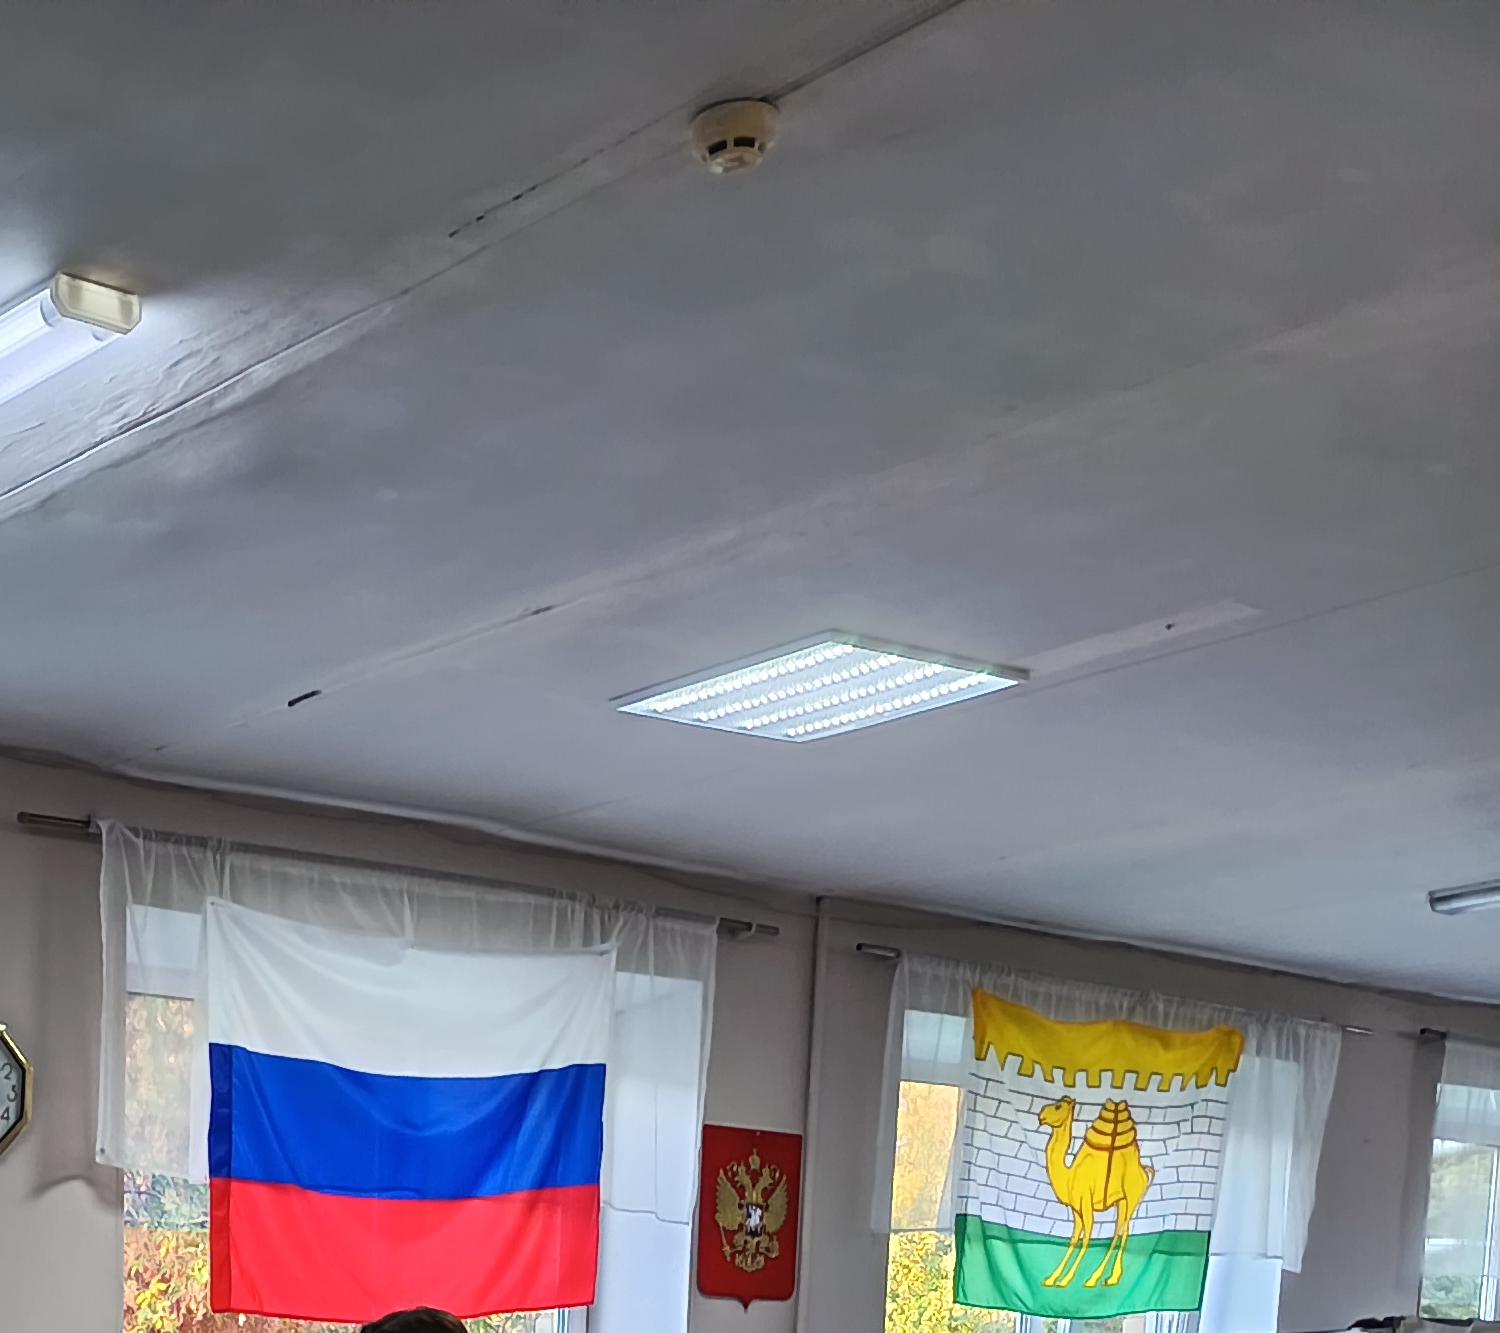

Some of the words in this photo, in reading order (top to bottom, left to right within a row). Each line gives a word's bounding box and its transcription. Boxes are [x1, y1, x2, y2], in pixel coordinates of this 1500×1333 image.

[1, 1062, 13, 1080] 2
[6, 1085, 17, 1102] 3
[0, 1106, 10, 1124] 4
